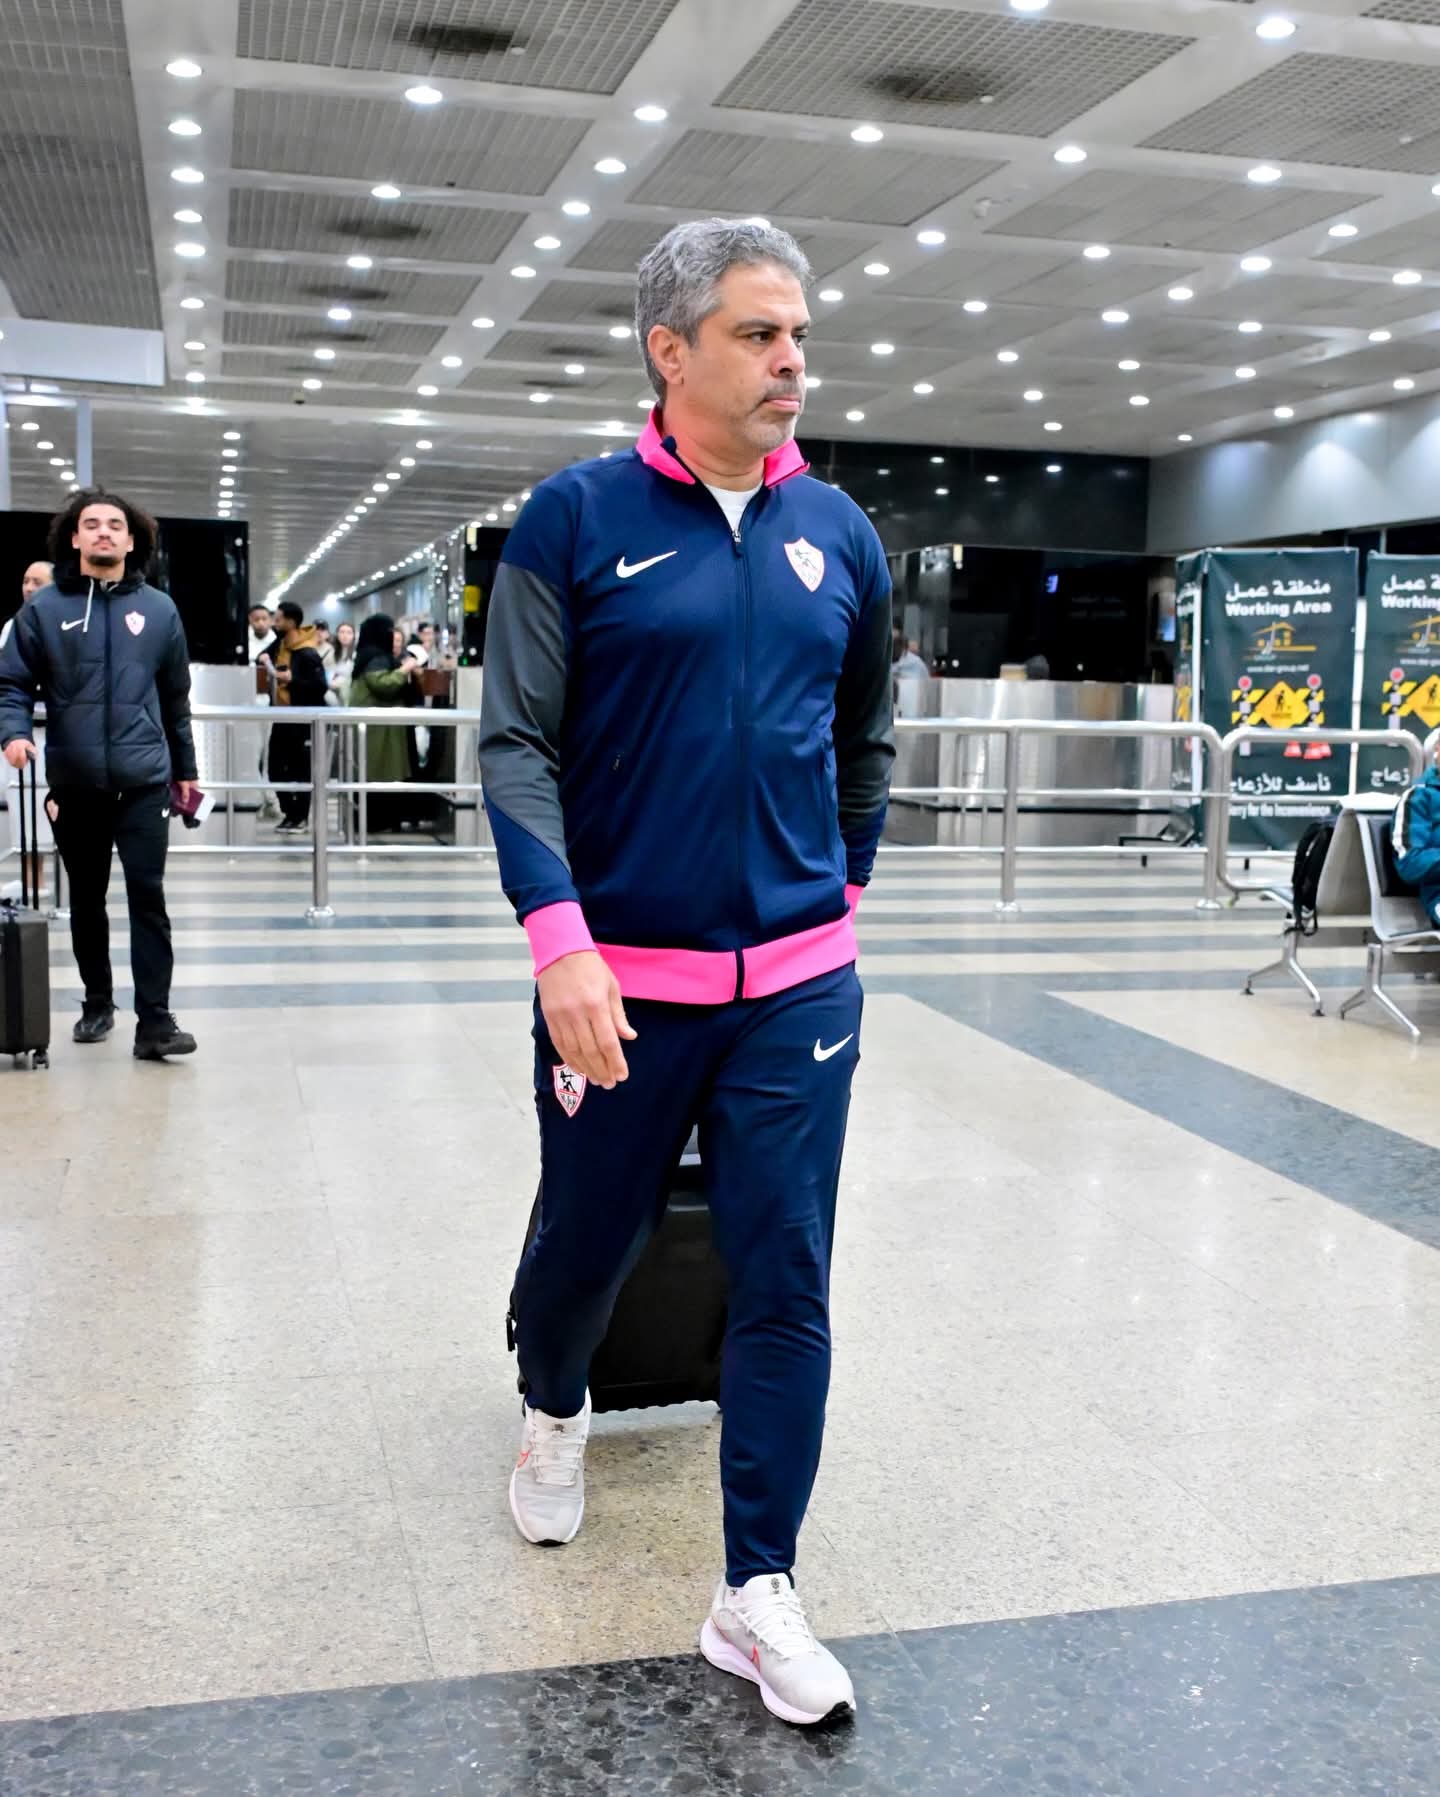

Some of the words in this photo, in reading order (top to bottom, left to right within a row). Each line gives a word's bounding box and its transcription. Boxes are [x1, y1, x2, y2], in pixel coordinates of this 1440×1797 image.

[1225, 582, 1269, 602] عمل
[1272, 579, 1331, 596] منطقة
[1381, 573, 1427, 594] عمل
[1225, 601, 1290, 618] Working
[1292, 600, 1332, 614] Area
[1285, 772, 1331, 792] نأسف
